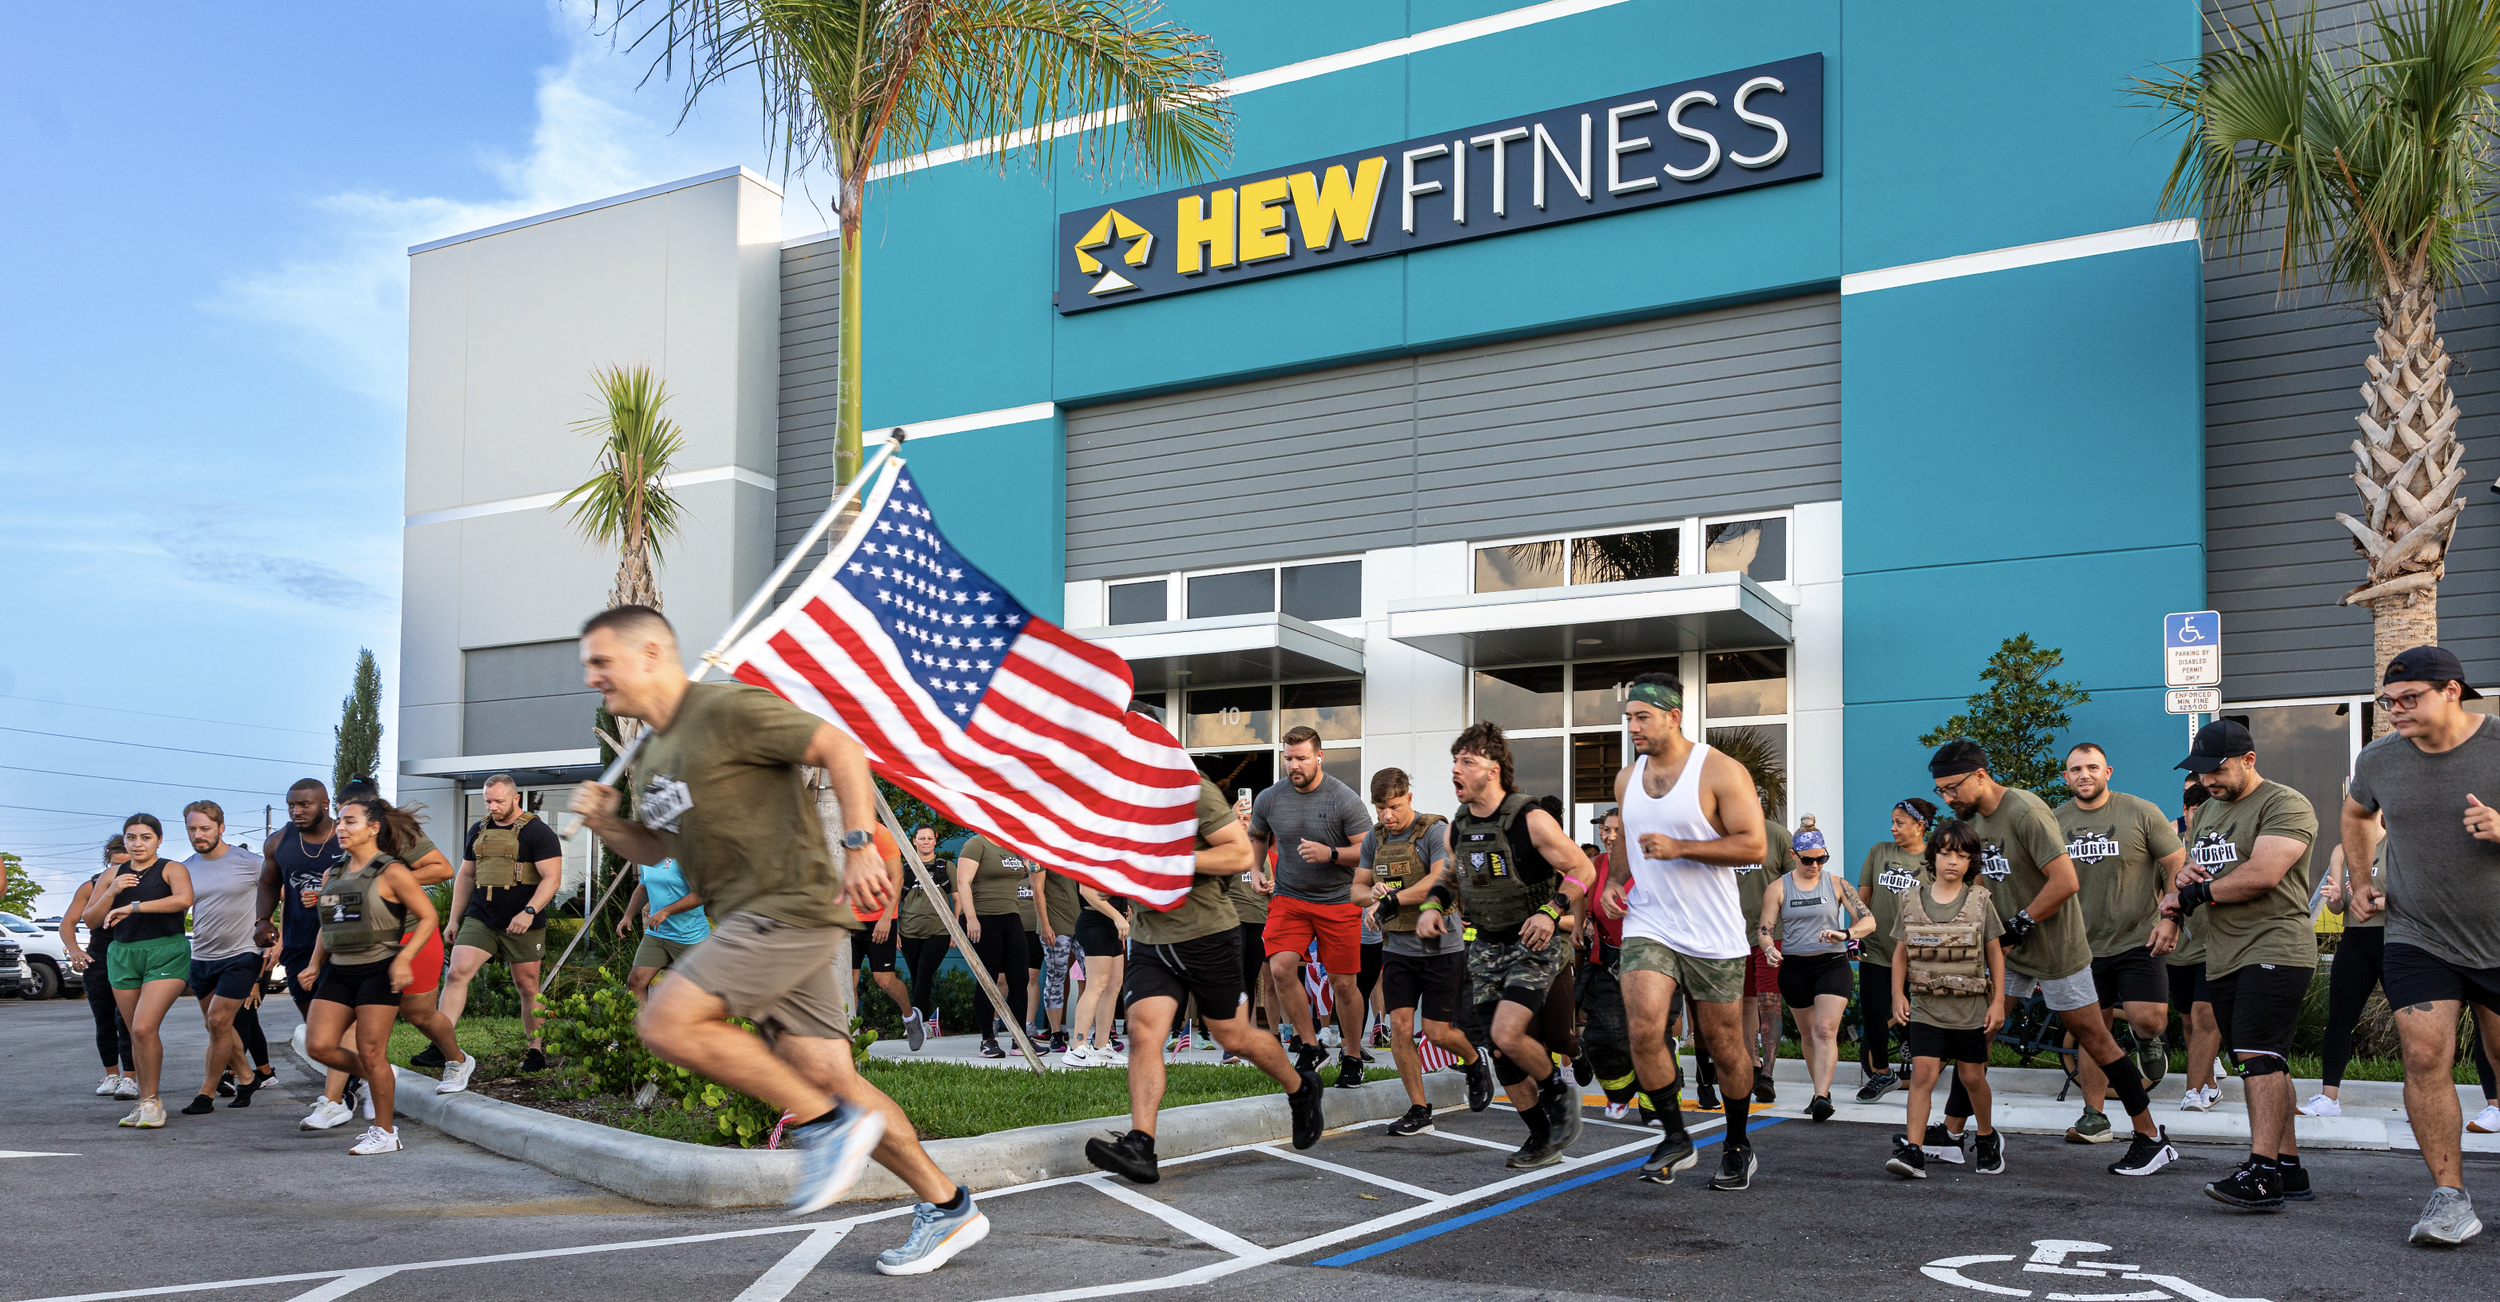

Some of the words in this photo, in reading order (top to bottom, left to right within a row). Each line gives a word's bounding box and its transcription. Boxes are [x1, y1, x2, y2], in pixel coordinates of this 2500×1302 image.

[1177, 156, 1388, 275] HEW
[1402, 76, 1789, 234] FITNESS
[1219, 706, 1240, 726] 10
[2067, 843, 2116, 856] MURPH
[2192, 845, 2234, 863] MURPH
[1490, 853, 1502, 876] HEW
[1386, 880, 1402, 888] HEW
[1880, 875, 1917, 888] MURPH
